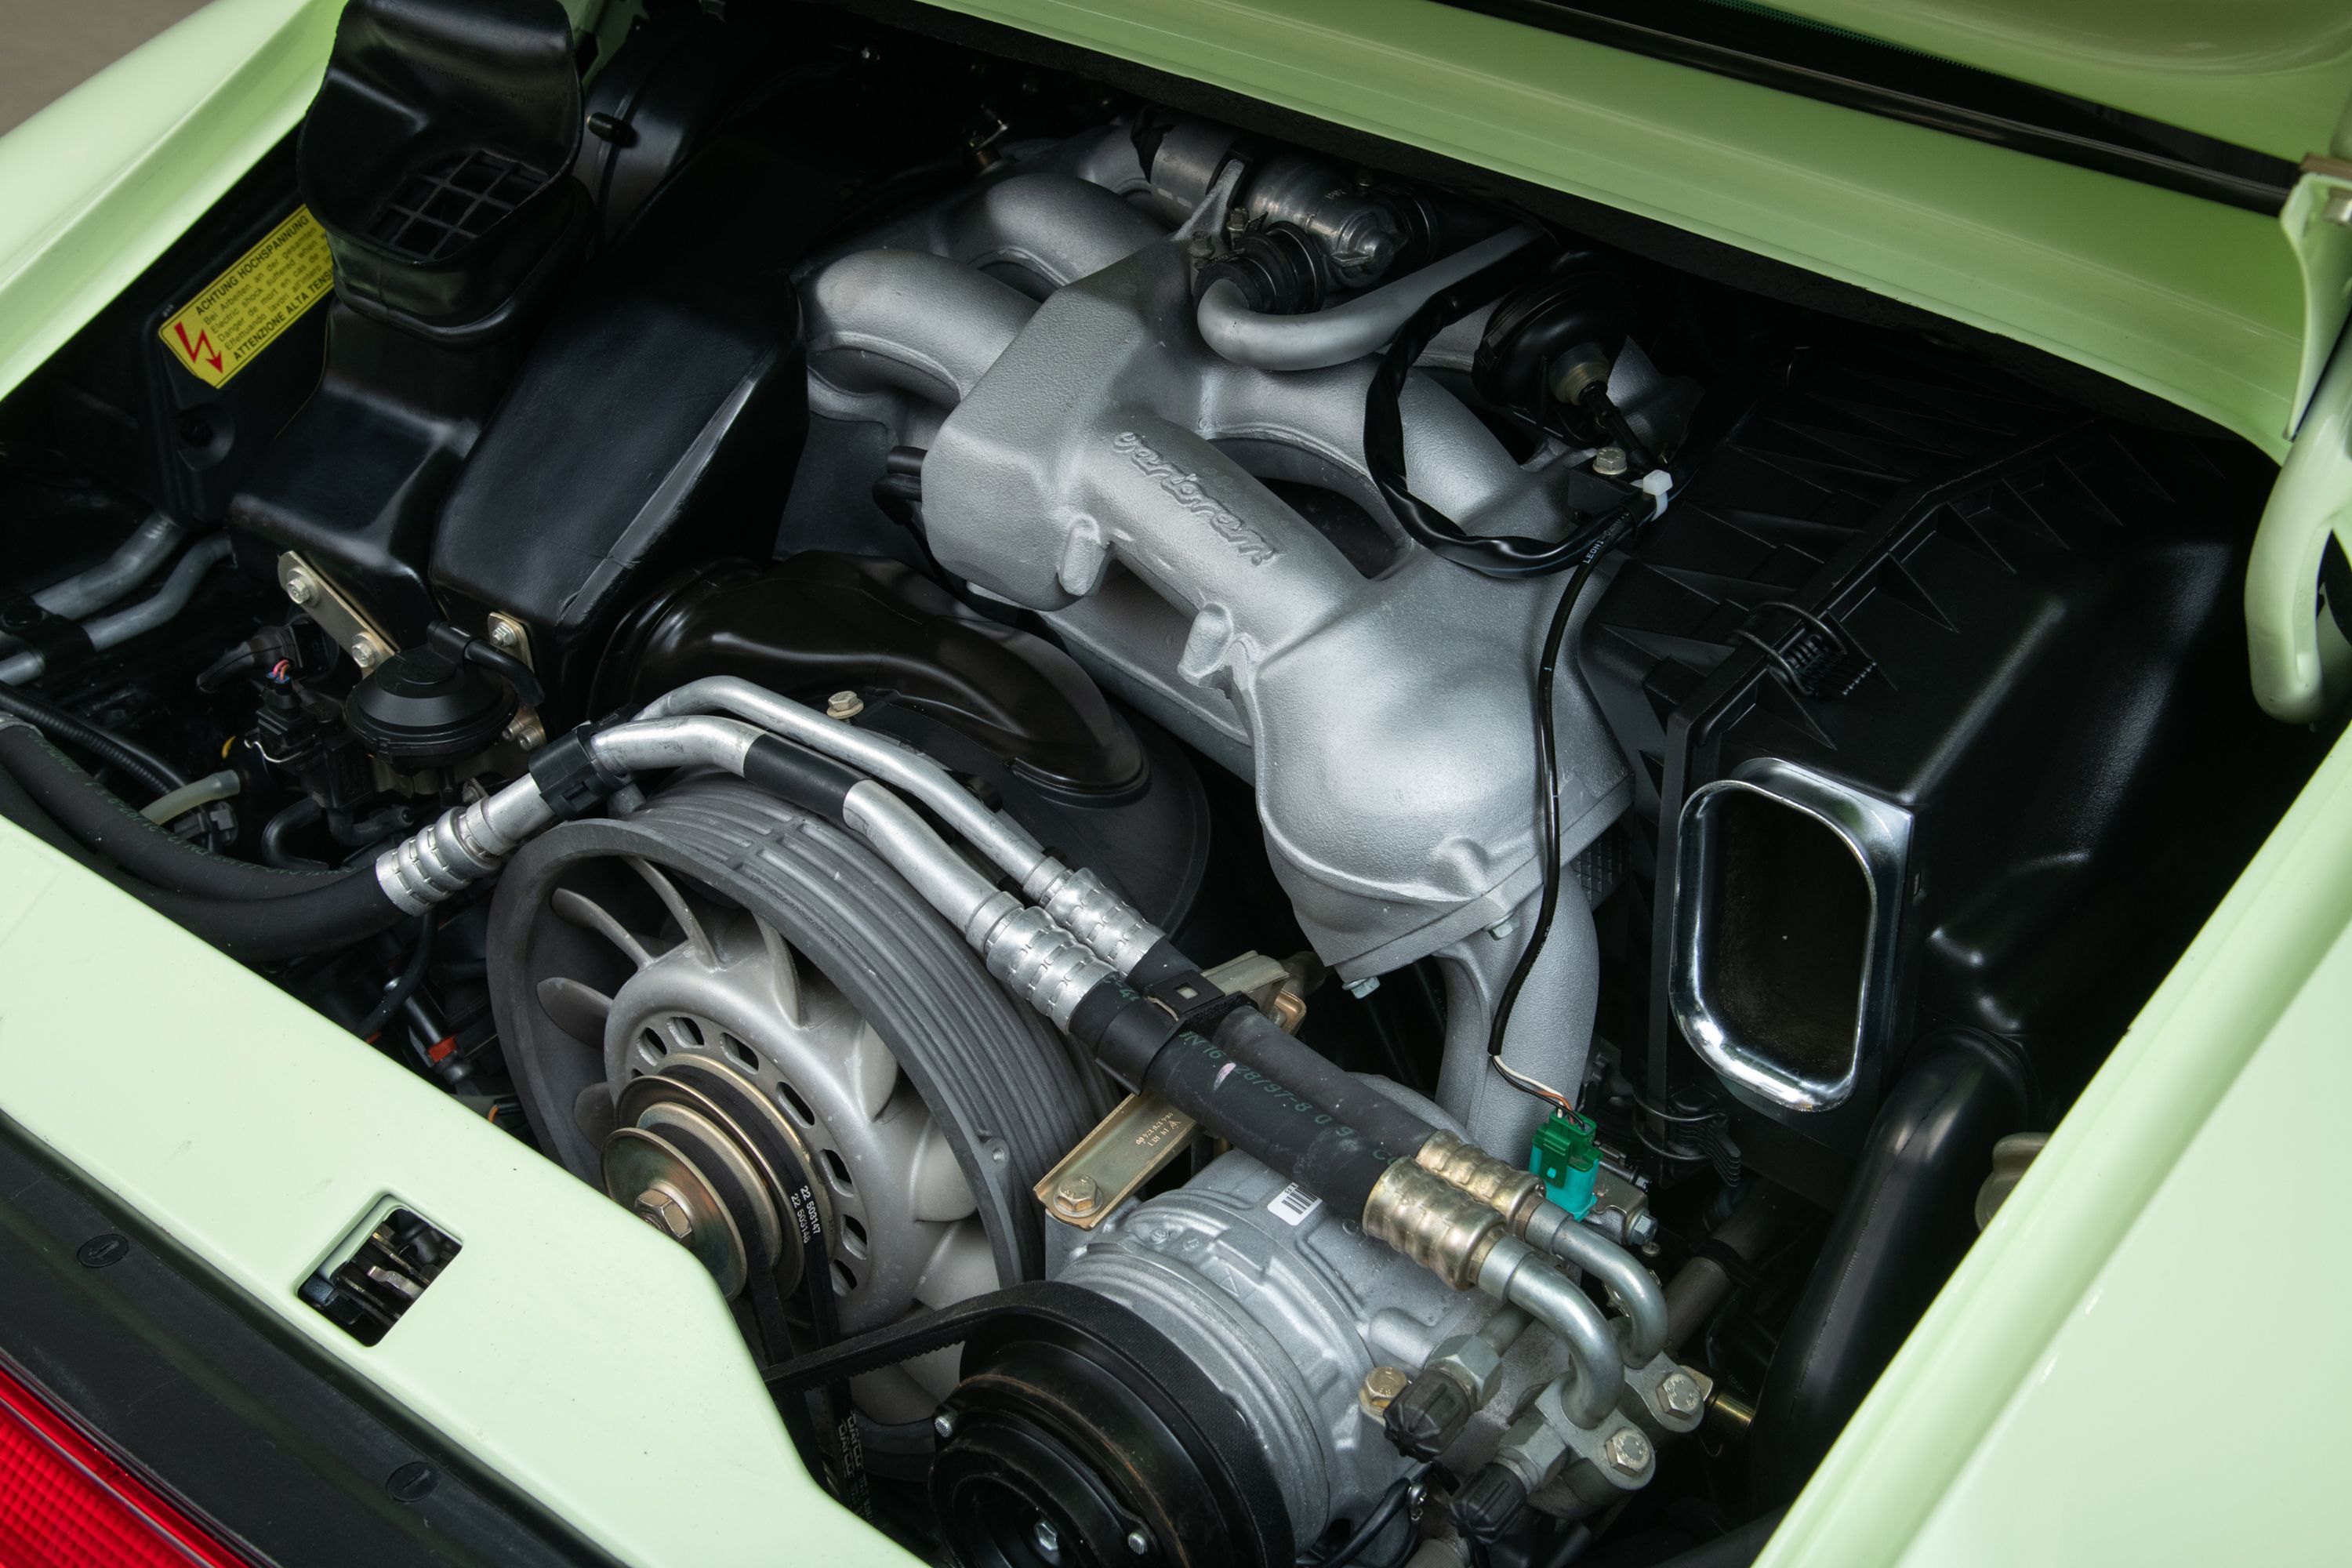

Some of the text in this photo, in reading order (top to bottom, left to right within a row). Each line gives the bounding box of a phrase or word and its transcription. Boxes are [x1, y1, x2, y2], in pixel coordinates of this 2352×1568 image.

[196, 216, 309, 316] ACHTUNG HOCHSPANNUNG
[203, 310, 218, 325] Bei
[220, 284, 251, 311] Arbeiten
[253, 273, 264, 284] an
[267, 260, 279, 272] der
[281, 227, 317, 259] gesamten
[210, 241, 318, 335] Electric shock suffered when
[217, 318, 246, 342] Danger
[248, 306, 259, 317] de
[260, 289, 278, 306] mort
[280, 278, 290, 289] en
[293, 266, 307, 278] cas
[309, 252, 319, 263] de
[224, 313, 267, 351] Effettuando
[269, 294, 289, 314] lavori
[233, 314, 286, 361] ATTENZIONE
[285, 293, 310, 314] ALTA
[1582, 540, 1604, 564] LEONI
[1202, 1046, 1226, 1059] 16
[791, 1192, 800, 1208] 22
[800, 1185, 821, 1234] 22 503147
